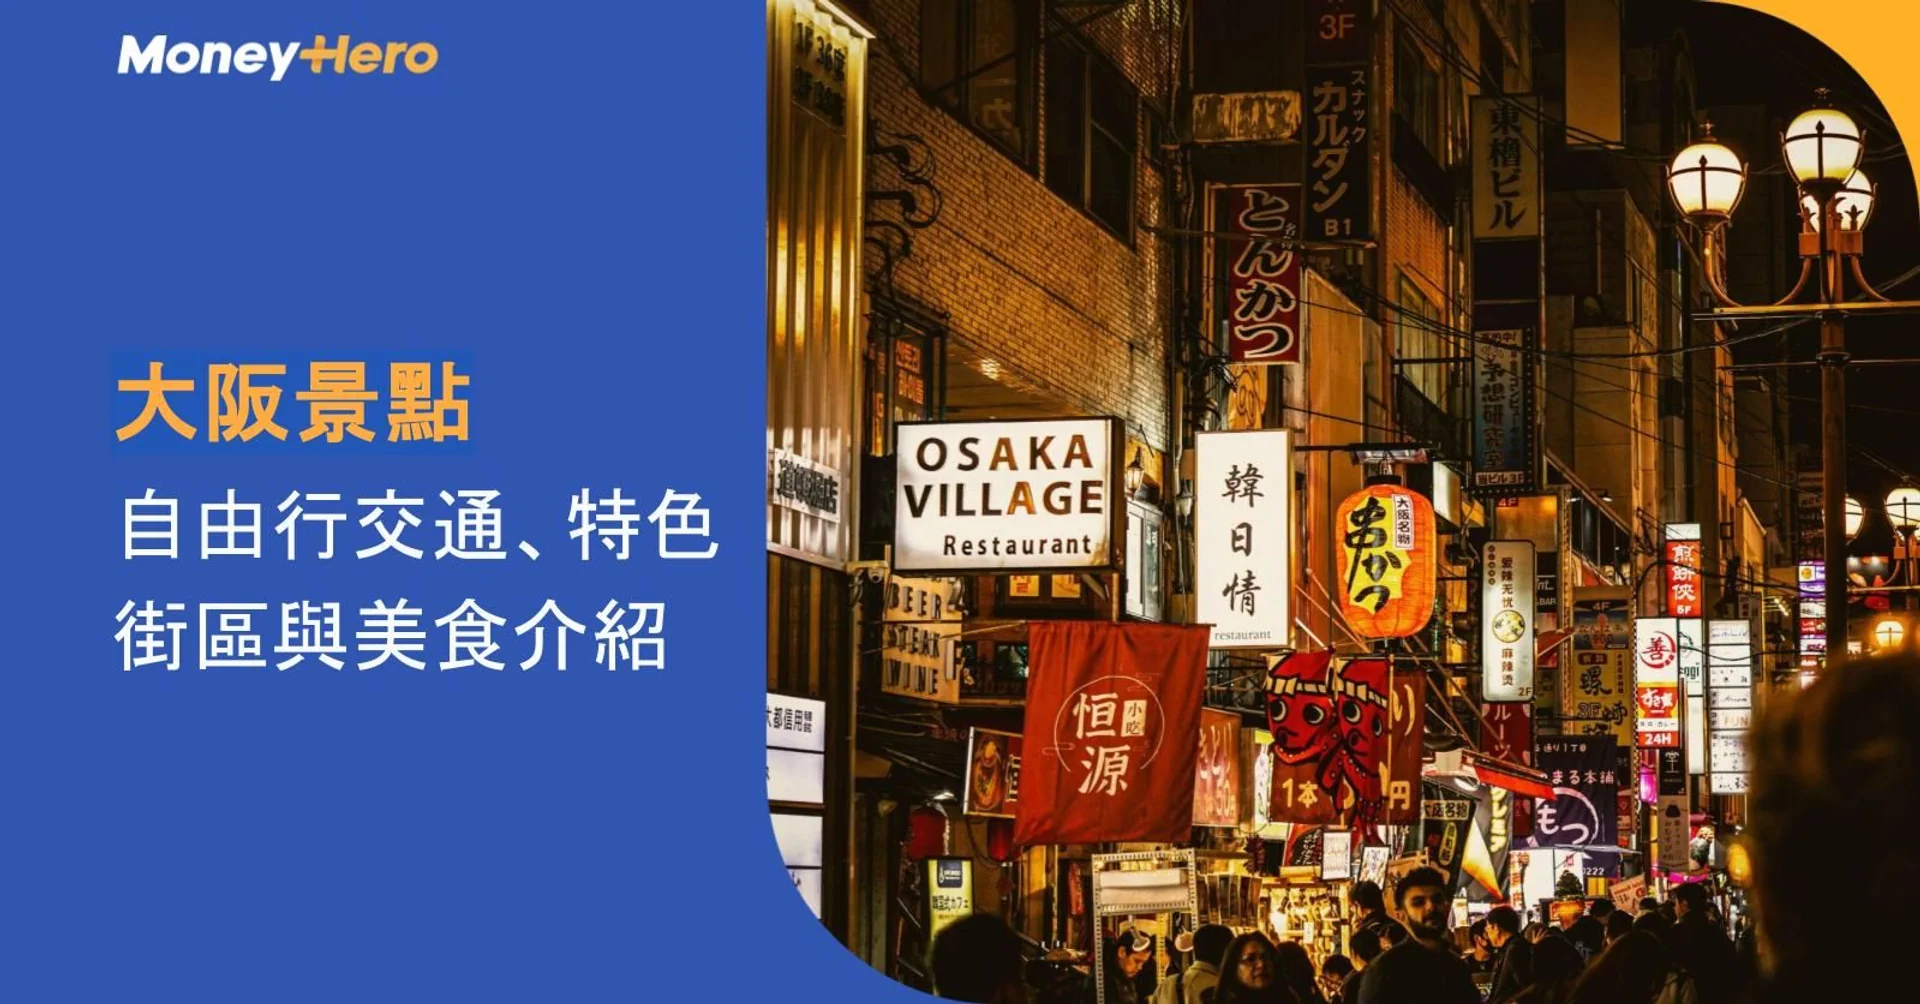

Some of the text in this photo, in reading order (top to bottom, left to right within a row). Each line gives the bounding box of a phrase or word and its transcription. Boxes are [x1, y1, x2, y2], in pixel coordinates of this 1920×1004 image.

[1319, 13, 1356, 40] 3F
[1350, 69, 1367, 144] スナック
[1311, 80, 1350, 213] カルダン
[1324, 217, 1351, 237] B1
[1233, 188, 1297, 359] とんかつ
[916, 434, 1093, 472] OSAKA
[903, 480, 1104, 518] VILLAGE
[1396, 497, 1411, 546] 大阪名物
[943, 534, 1091, 556] Restaurant
[1220, 462, 1265, 617] 韓日情
[1345, 496, 1402, 613] 串かつ
[887, 583, 941, 620] BEER
[887, 623, 940, 658] STEAK
[1214, 629, 1271, 641] restaurant
[1642, 636, 1671, 662] 善
[887, 659, 938, 695] WINE
[1517, 686, 1532, 698] 2F
[1125, 701, 1144, 735] 小吃
[1073, 692, 1131, 797] 恒源
[1645, 733, 1672, 747] 24H
[1282, 781, 1318, 808] 1本
[1545, 770, 1614, 785] まる本舗
[1389, 781, 1411, 810] 円
[1537, 804, 1590, 845] もつ
